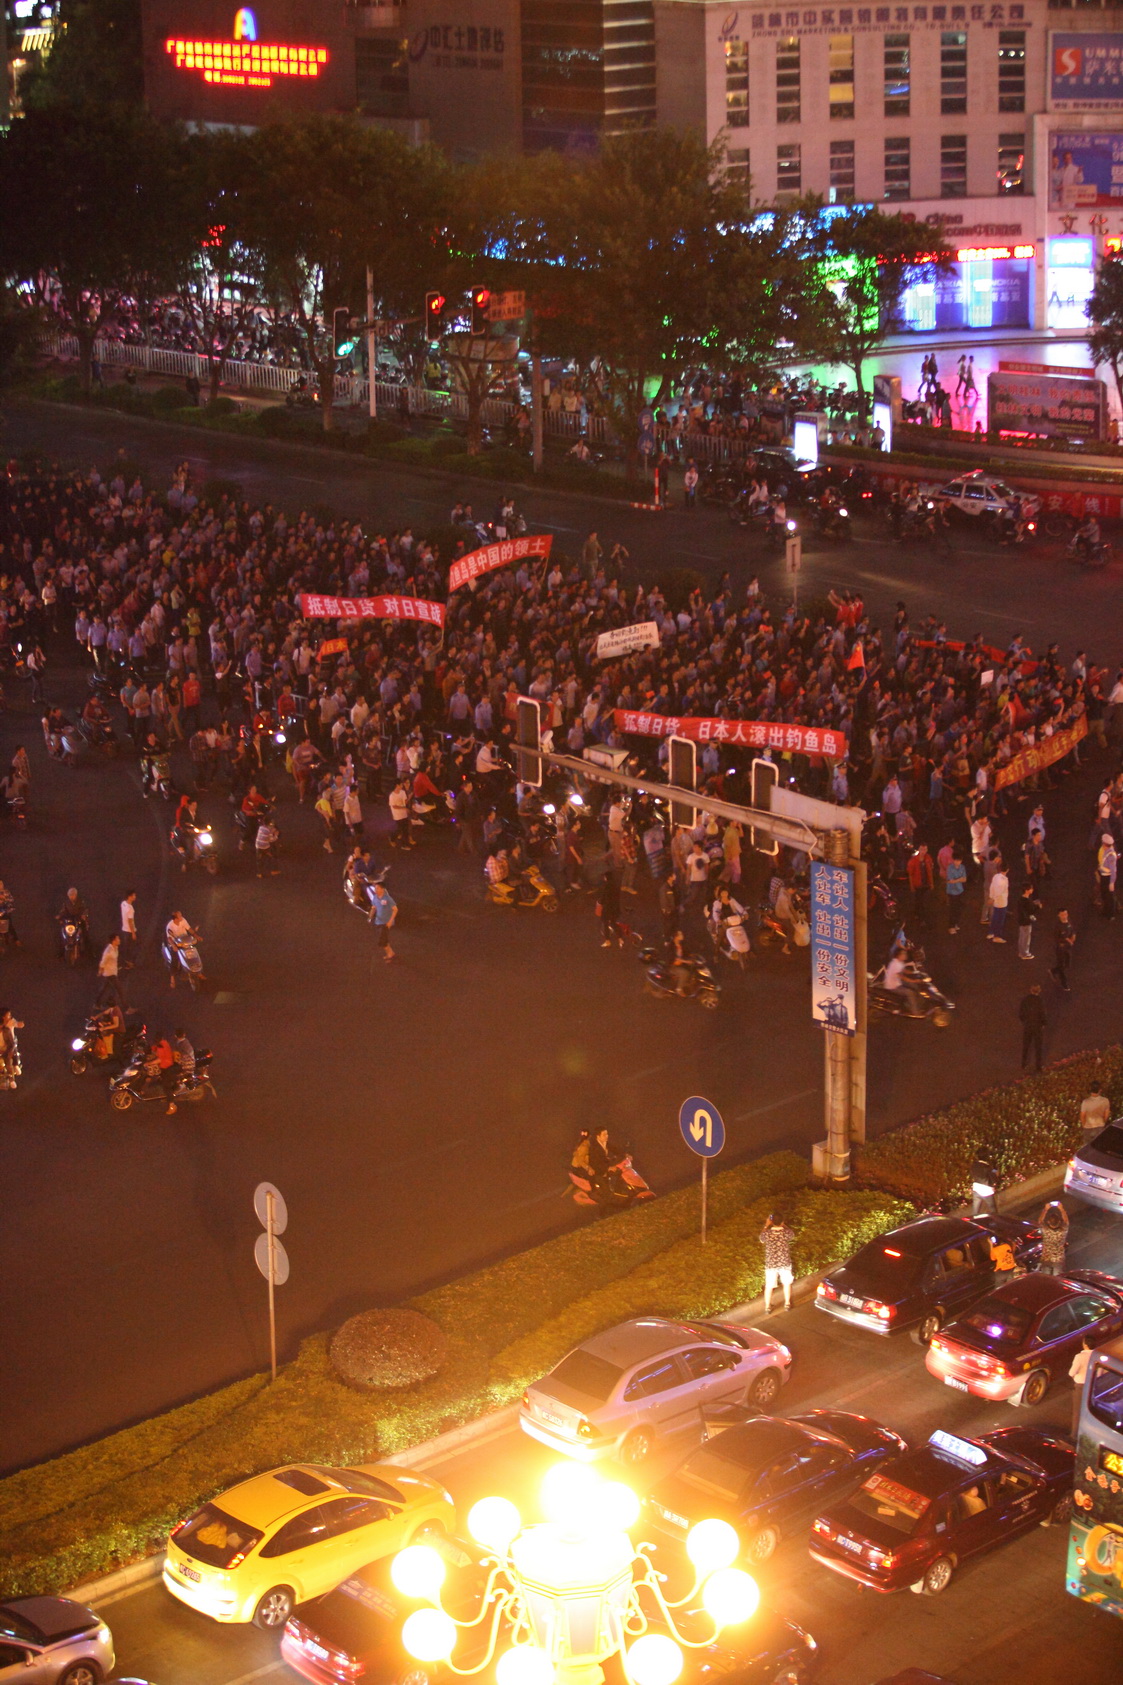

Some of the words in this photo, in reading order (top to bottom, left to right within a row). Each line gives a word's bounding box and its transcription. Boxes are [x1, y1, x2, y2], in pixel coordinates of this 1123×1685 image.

[307, 597, 376, 616] 抵制日货
[383, 598, 442, 625] 对日宣战
[816, 866, 832, 906] 人让车
[832, 870, 849, 912] 车让人
[816, 909, 832, 988] 让出一份安全
[833, 914, 849, 993] 让出一份文明
